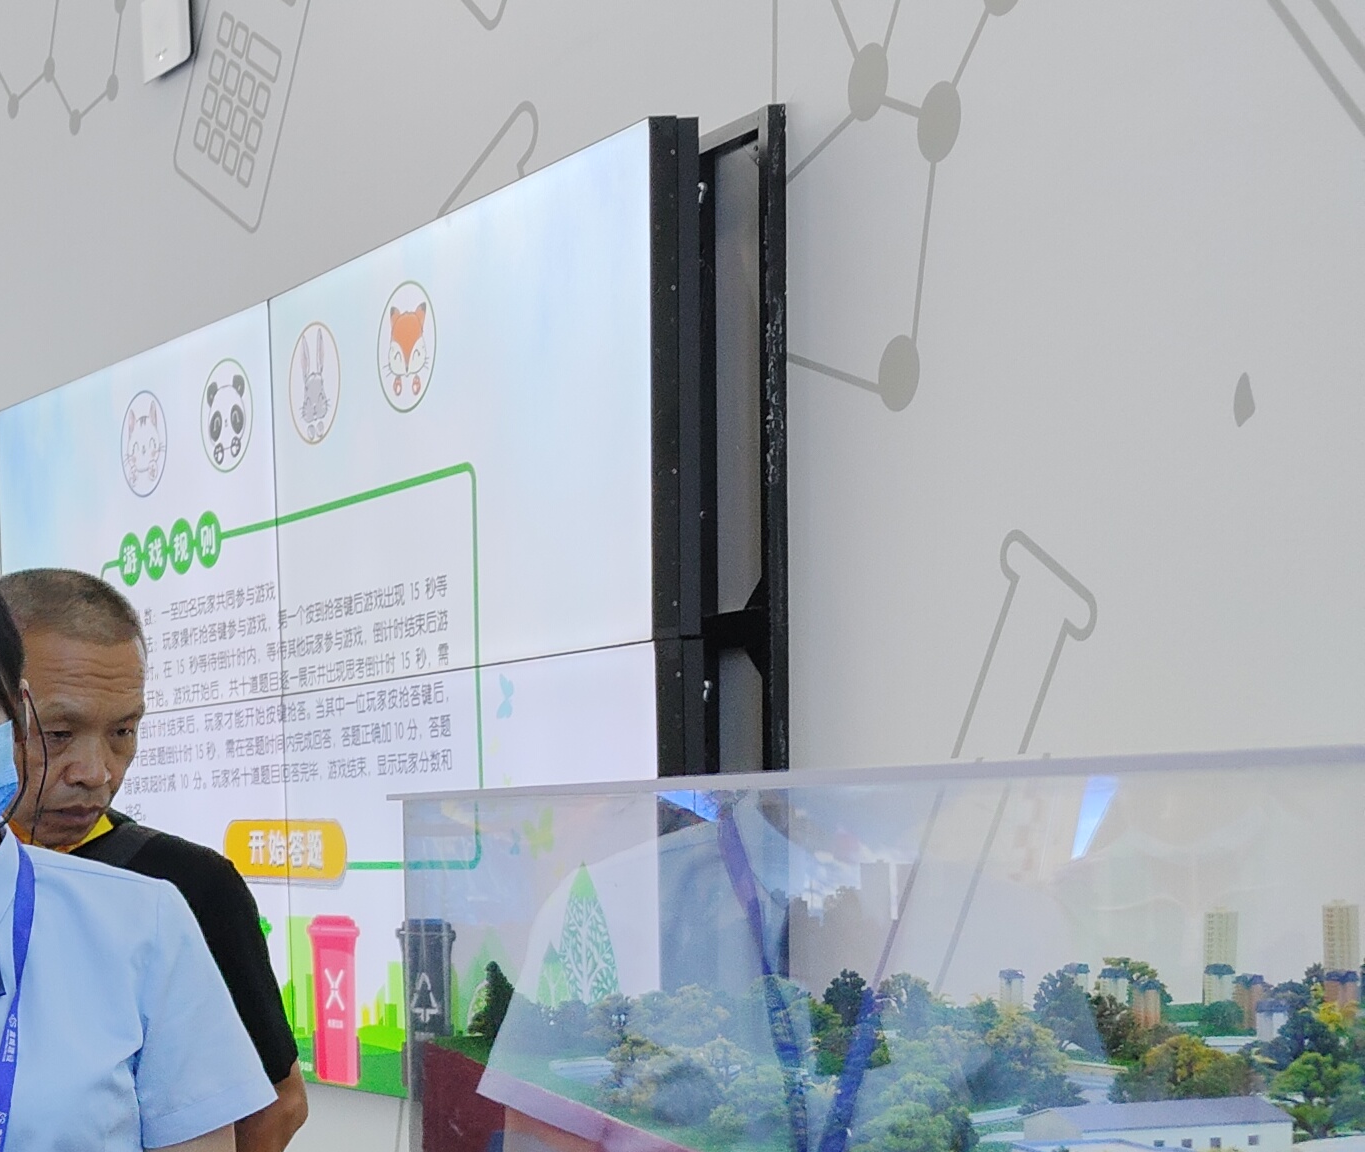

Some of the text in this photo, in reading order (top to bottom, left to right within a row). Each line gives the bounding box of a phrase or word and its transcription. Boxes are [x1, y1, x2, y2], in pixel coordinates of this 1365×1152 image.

[123, 523, 217, 575] 游戏规则
[410, 581, 420, 601] 15
[176, 658, 185, 675] 15
[401, 650, 411, 671] 15
[195, 743, 204, 760] 15
[394, 721, 404, 741] 10
[180, 773, 189, 790] 10
[248, 829, 324, 870] 开始答题
